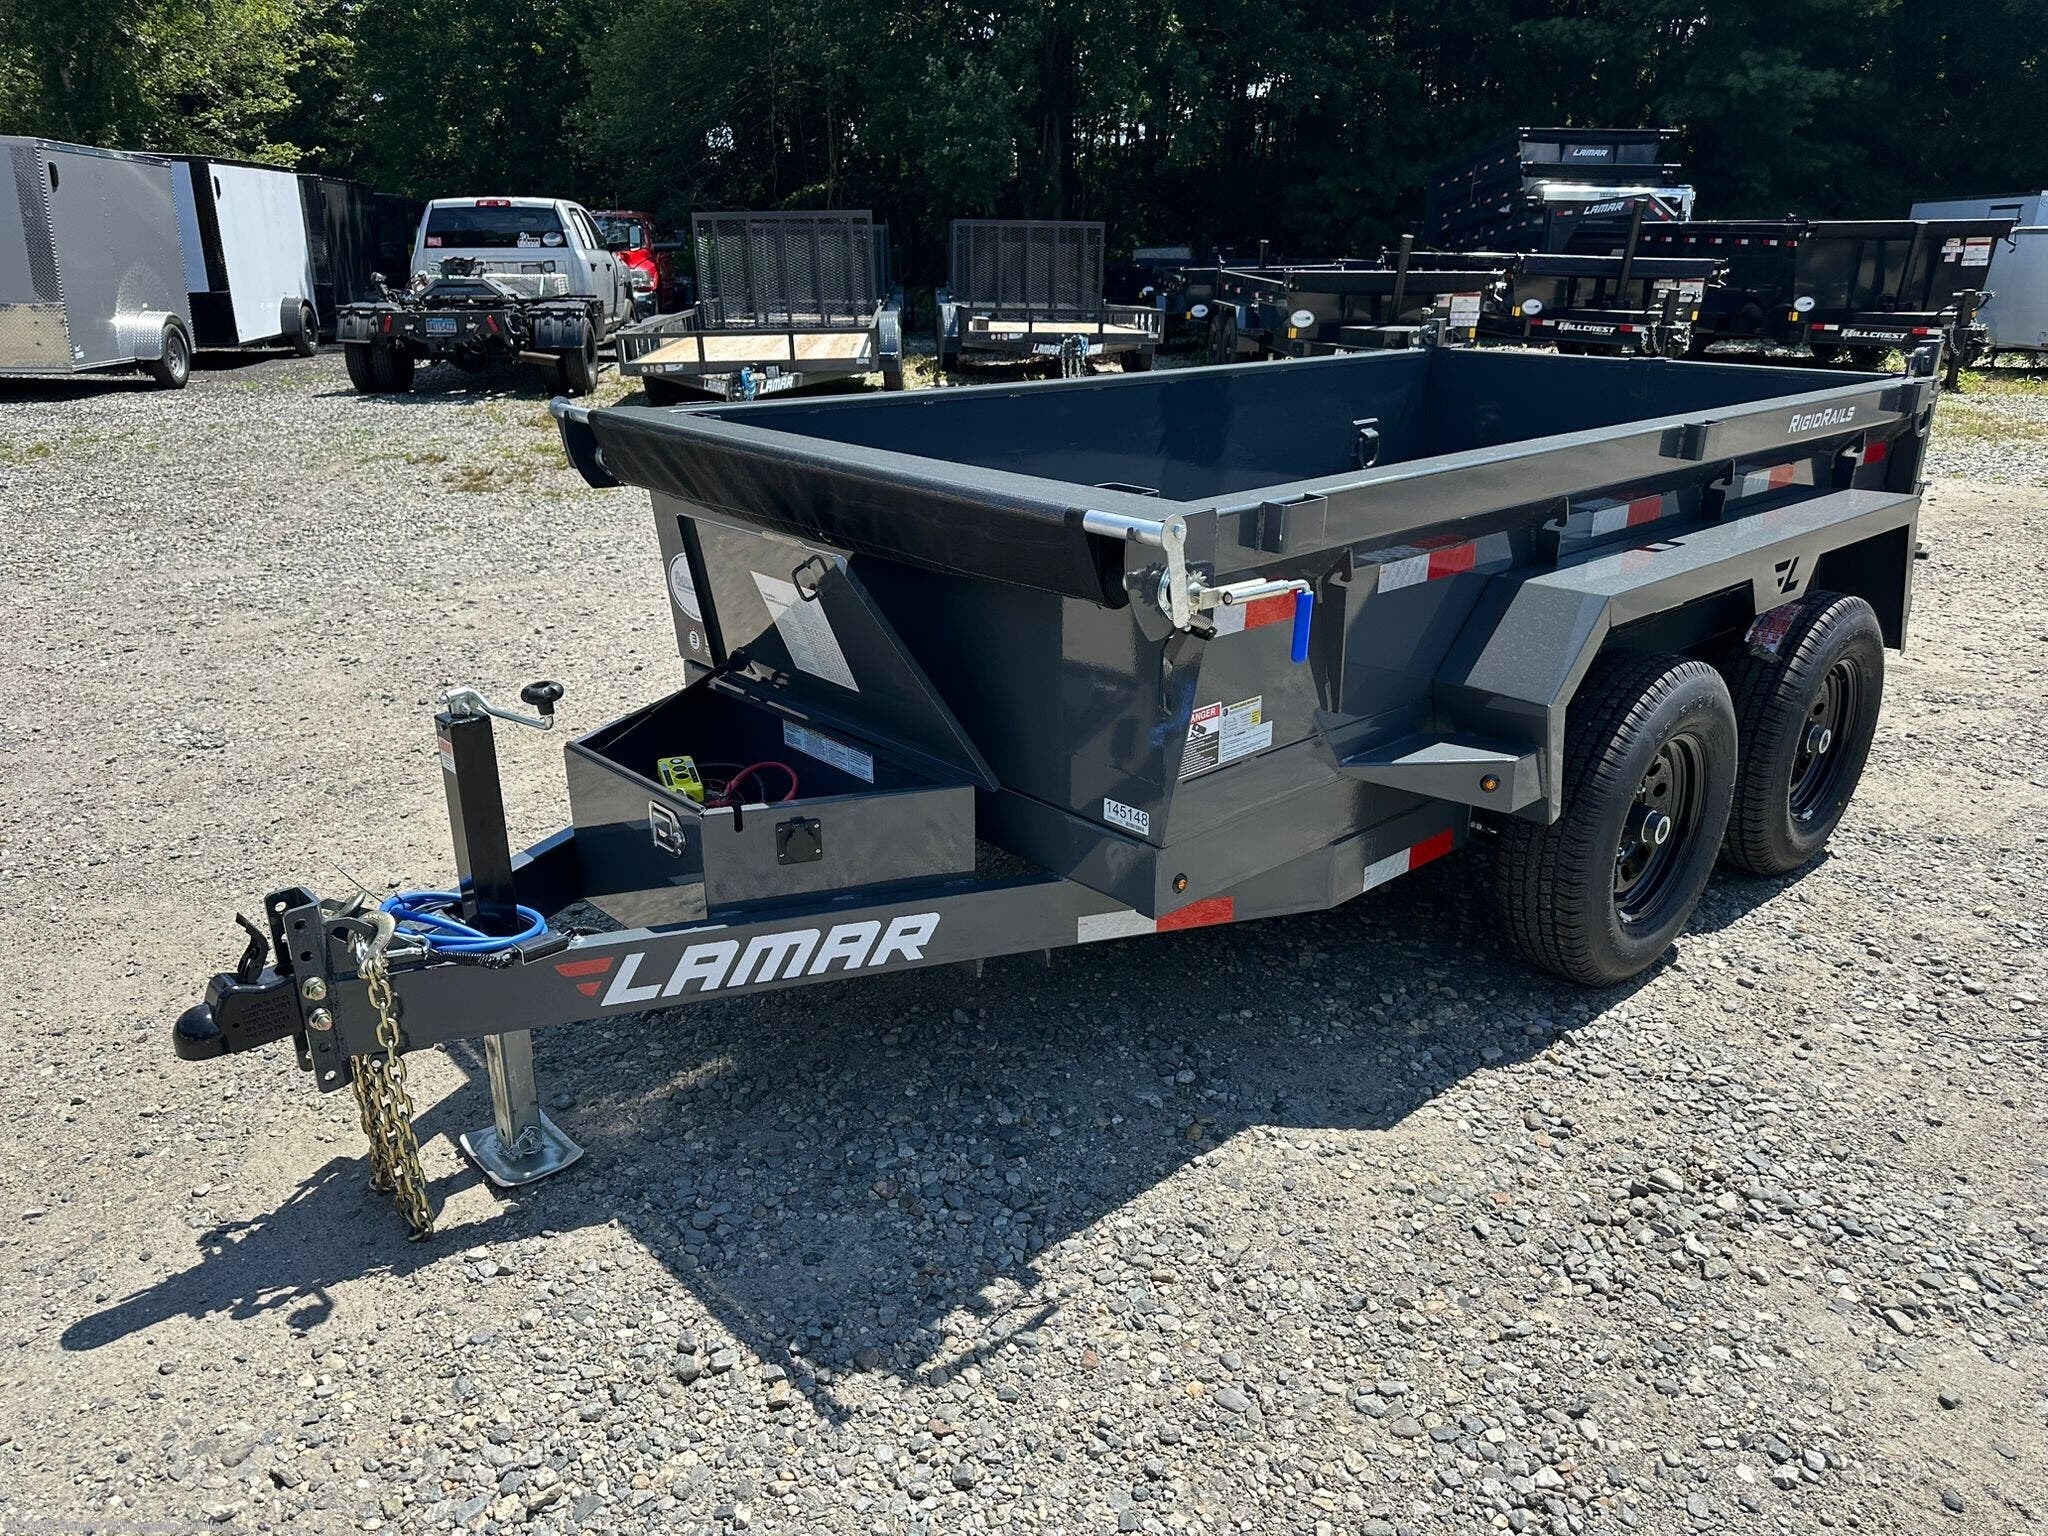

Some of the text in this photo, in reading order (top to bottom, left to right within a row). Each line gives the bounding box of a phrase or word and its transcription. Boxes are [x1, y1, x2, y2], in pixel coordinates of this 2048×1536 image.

[1573, 148, 1608, 157] LAMAR
[1583, 201, 1625, 216] LAMAR
[1558, 321, 1616, 334] HILLCREST
[1841, 328, 1908, 341] HILLCREST
[1032, 343, 1060, 355] LAMAR
[760, 374, 794, 394] LAMAR
[1190, 707, 1217, 724] ANGER
[1106, 801, 1148, 827] 145148
[601, 912, 941, 1007] LAMAR
